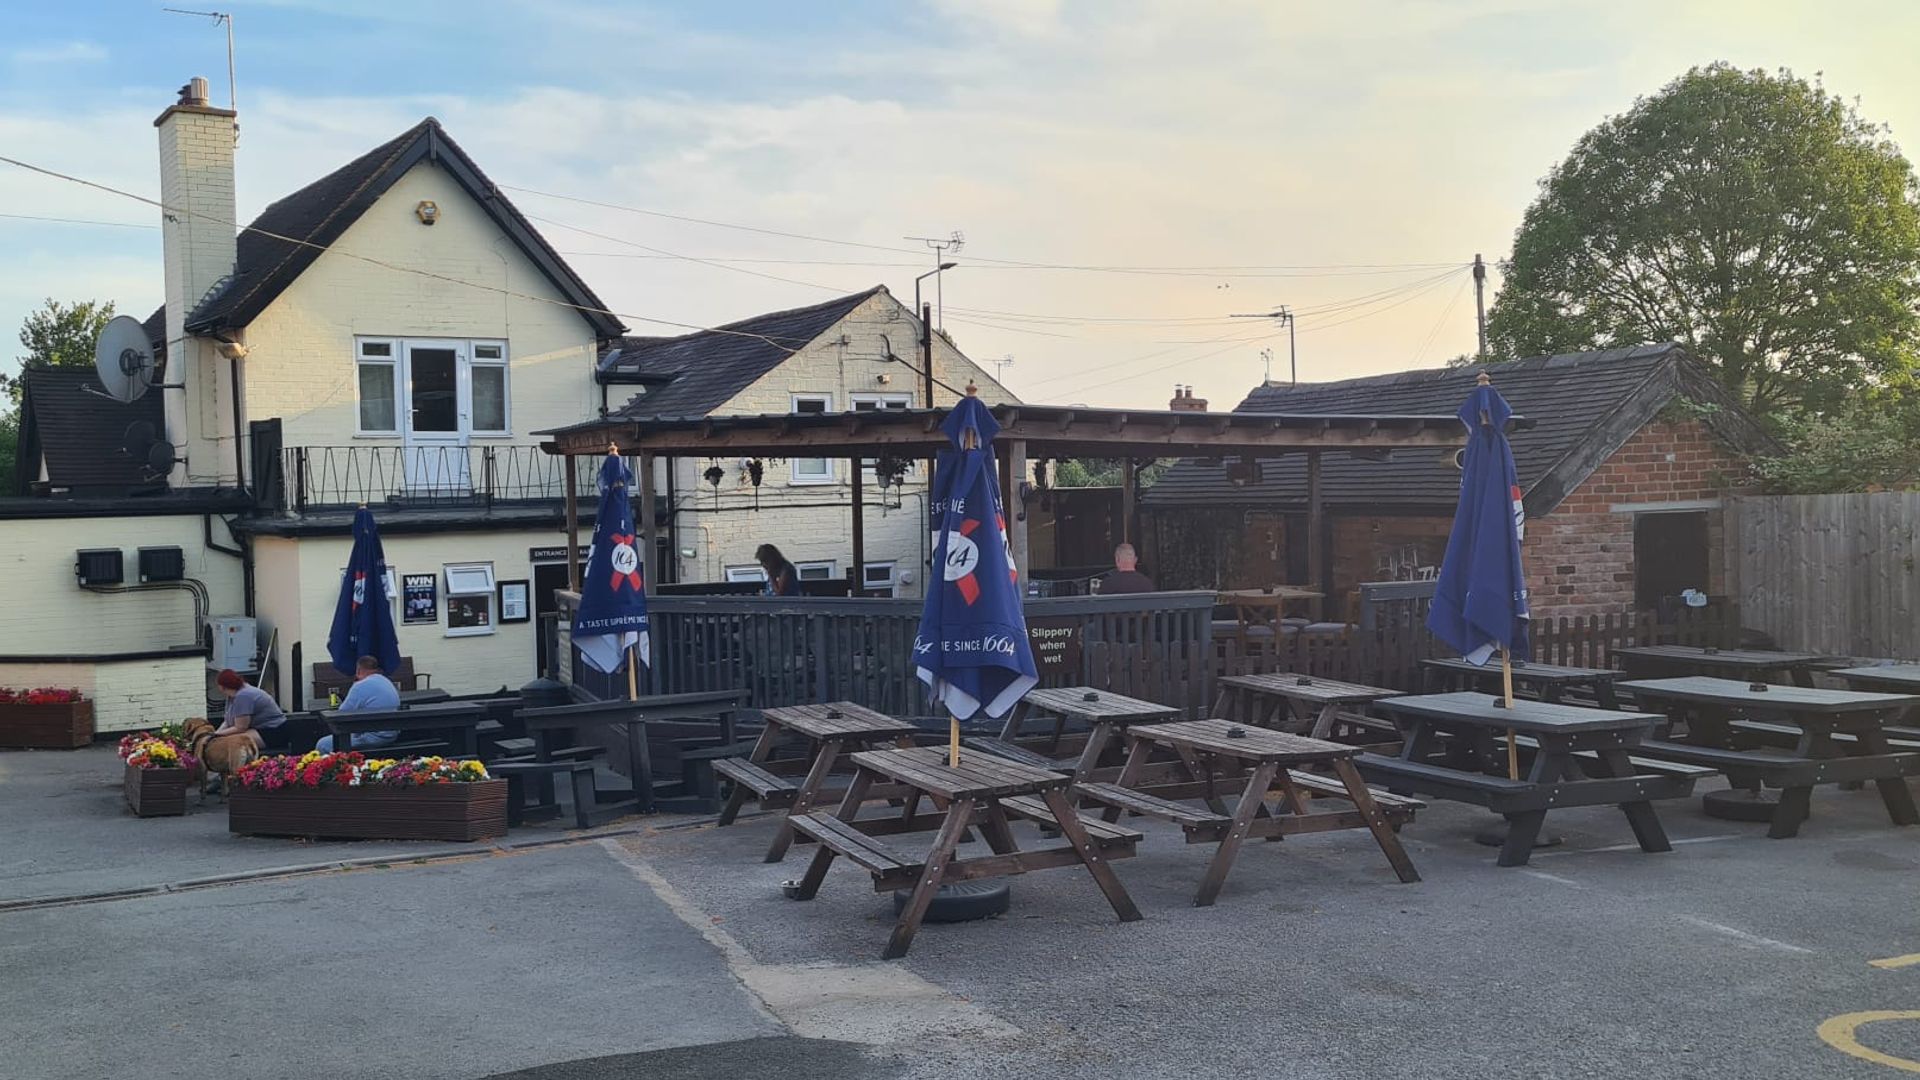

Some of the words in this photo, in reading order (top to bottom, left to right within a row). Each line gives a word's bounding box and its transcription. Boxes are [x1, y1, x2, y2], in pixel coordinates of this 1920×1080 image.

[534, 549, 568, 557] ENTRANCE
[406, 576, 433, 586] WIN
[586, 619, 609, 629] TASTE
[1031, 627, 1073, 639] Slippery
[953, 640, 981, 652] SINCE
[982, 633, 1016, 656] 1664
[1039, 640, 1066, 651] when
[1043, 653, 1063, 664] wet
